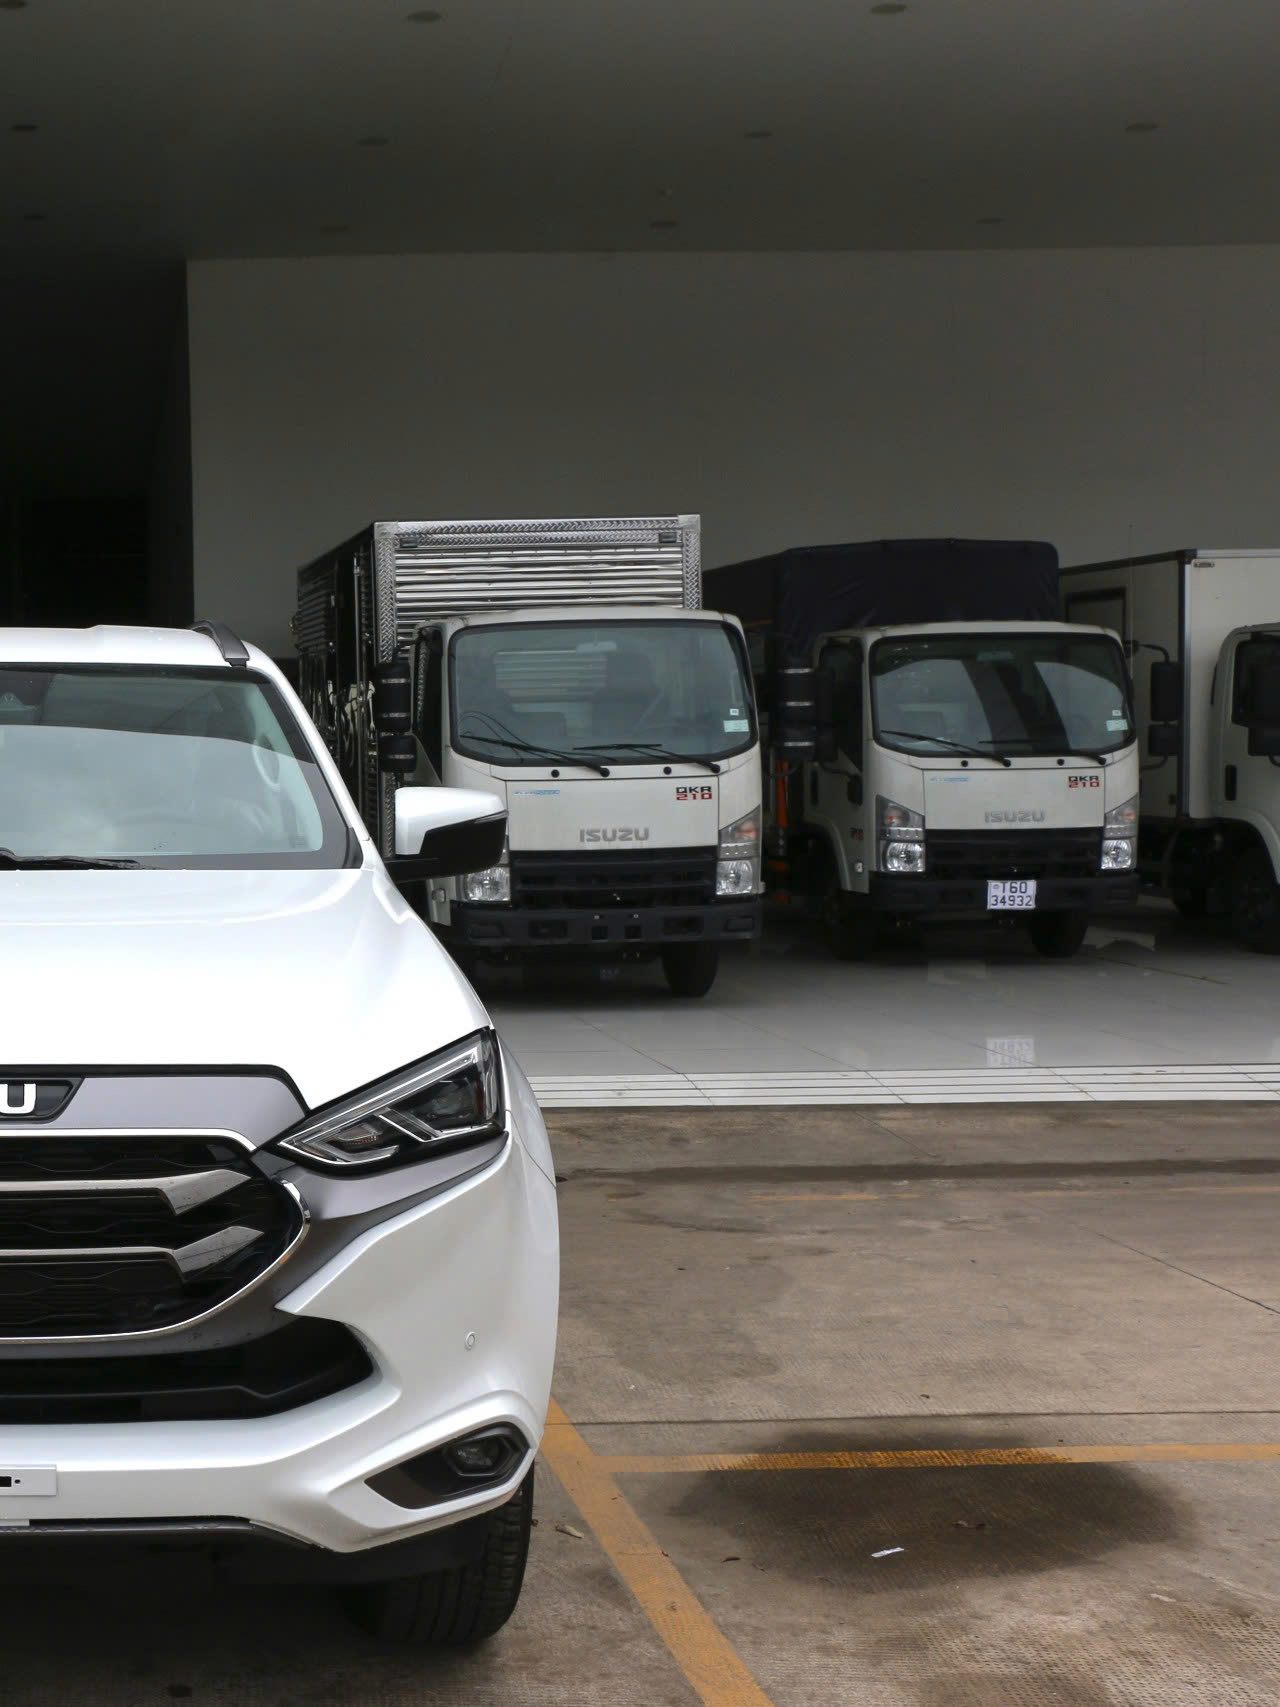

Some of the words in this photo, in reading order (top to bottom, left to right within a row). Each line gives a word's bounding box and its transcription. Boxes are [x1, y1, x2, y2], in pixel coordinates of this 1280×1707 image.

[676, 786, 712, 794] QKR
[985, 810, 1045, 823] ISUZU
[579, 827, 649, 842] ISUZU
[1000, 881, 1028, 894] T60
[991, 895, 1033, 907] 34932
